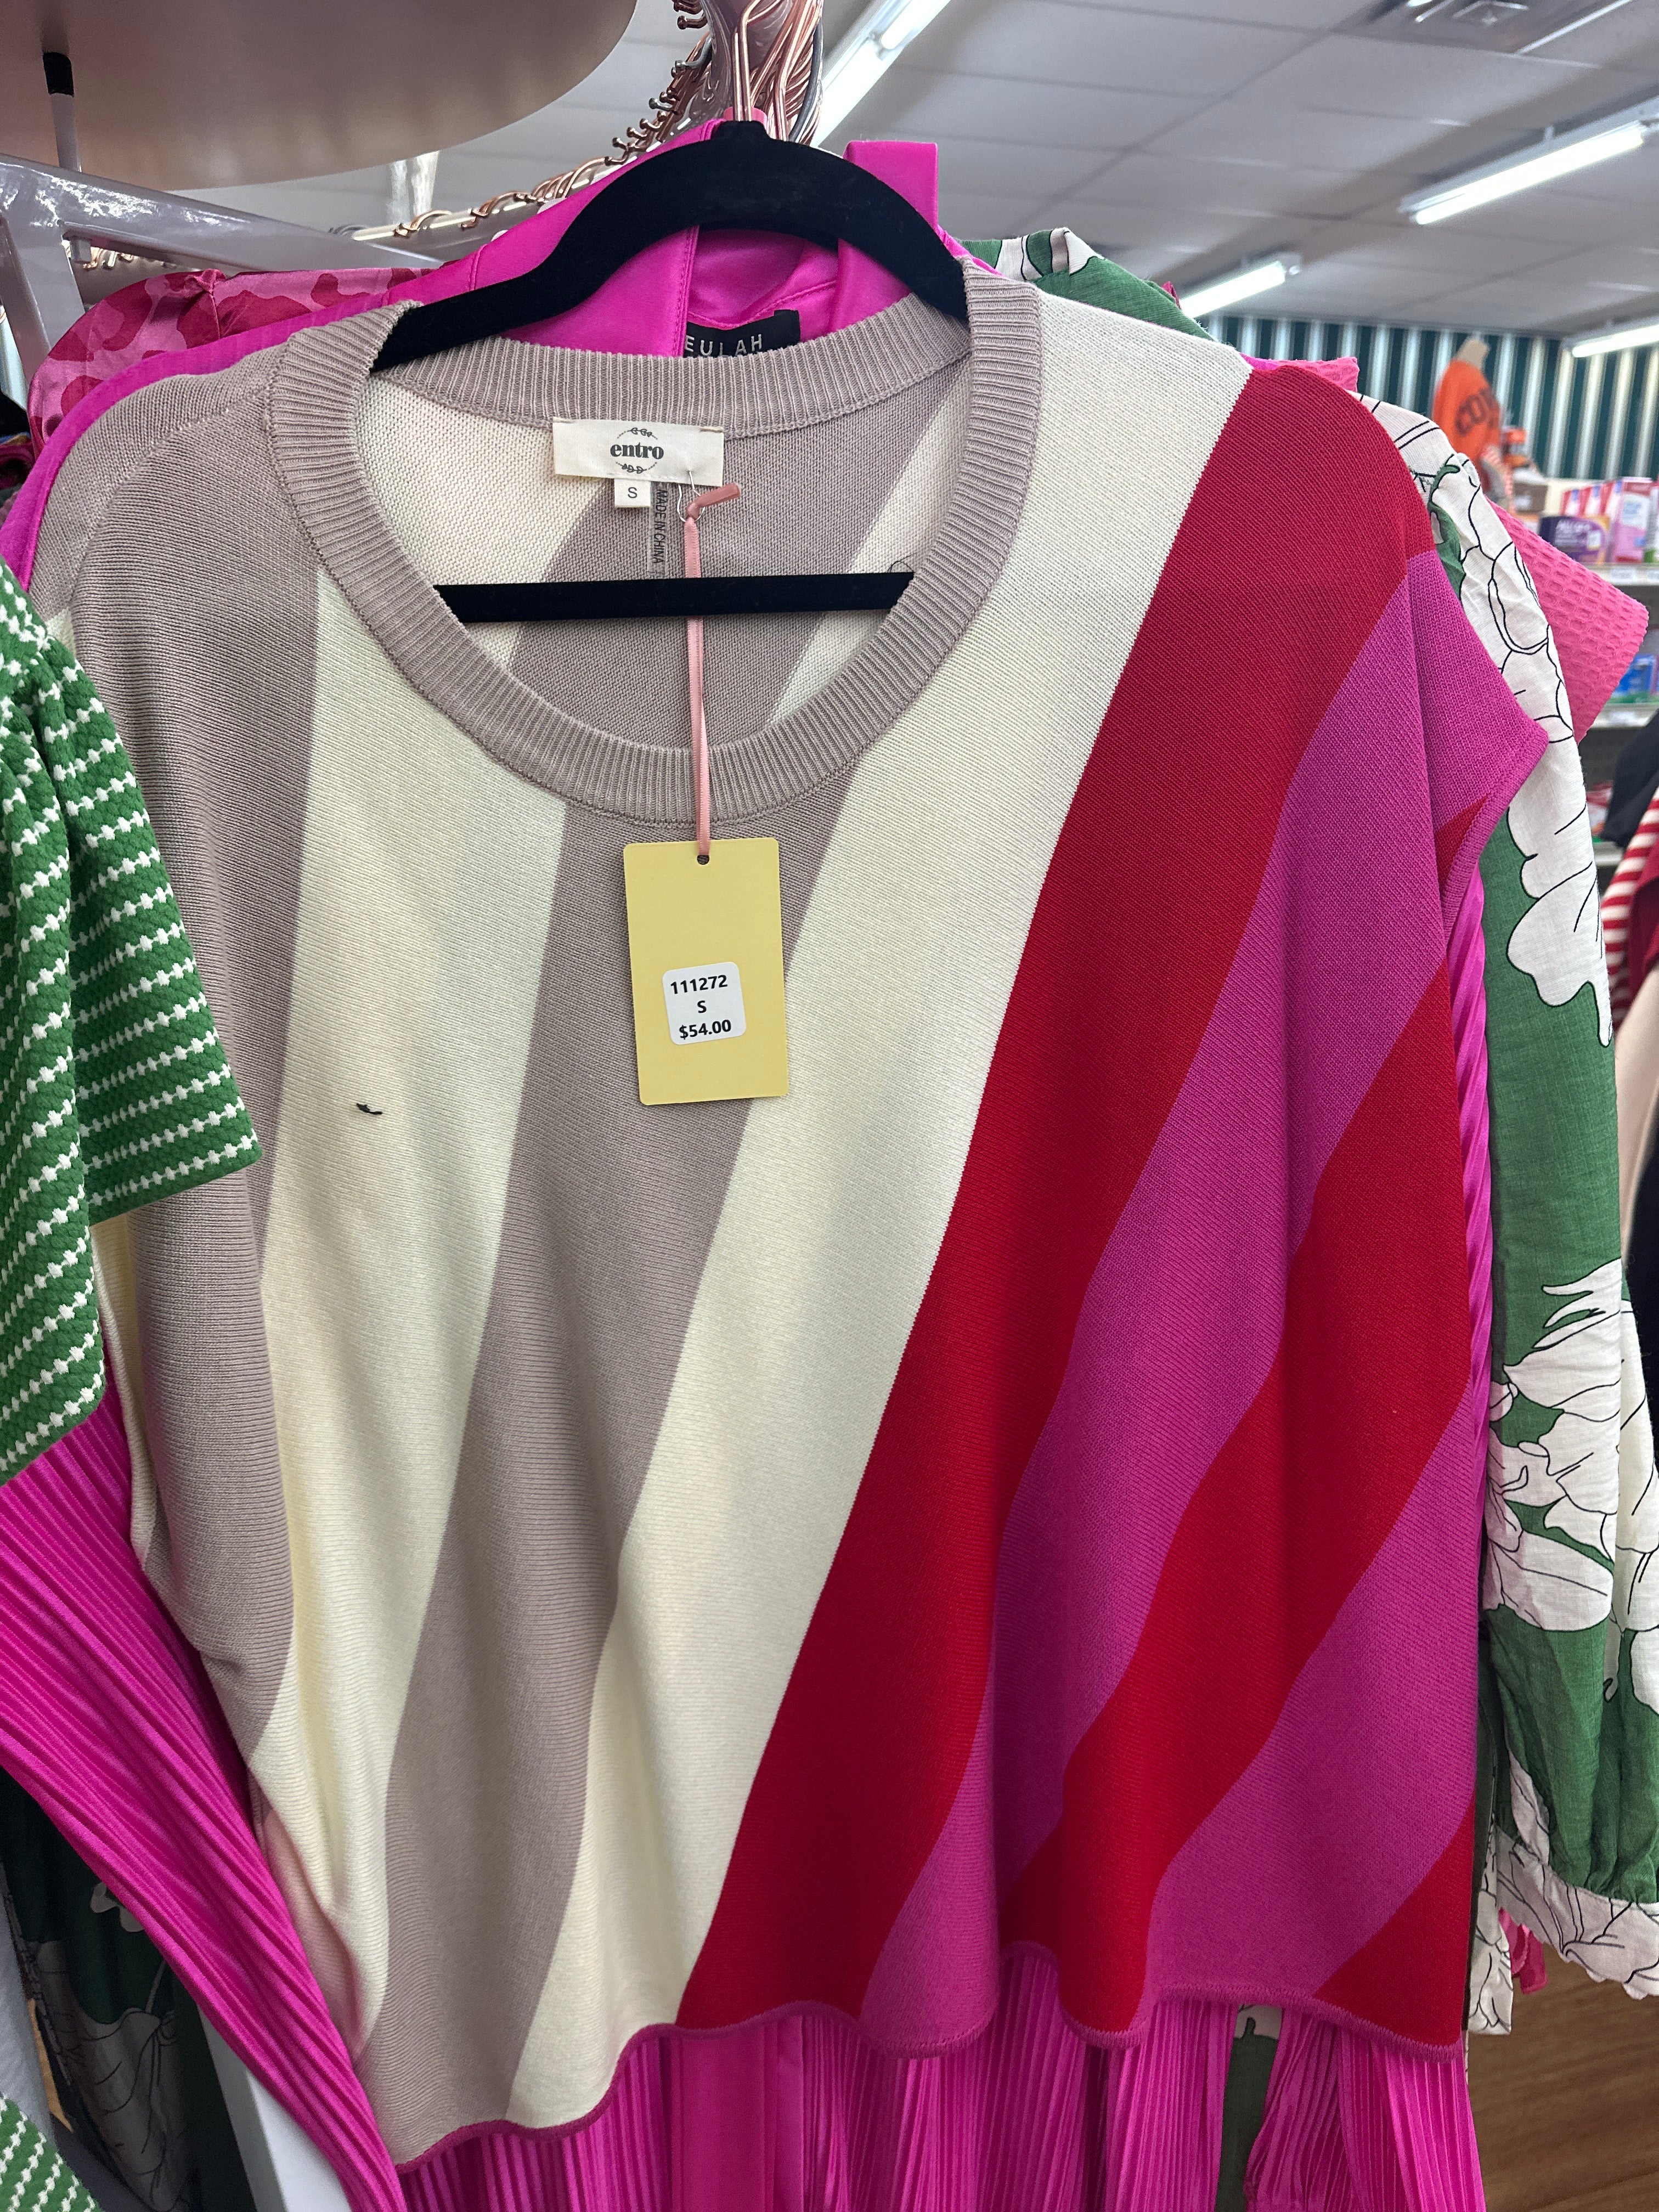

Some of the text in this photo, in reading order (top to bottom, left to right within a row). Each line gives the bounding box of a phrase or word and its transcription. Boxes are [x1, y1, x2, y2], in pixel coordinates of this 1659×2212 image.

[684, 334, 762, 357] EULAH
[610, 442, 664, 460] entro
[627, 486, 638, 499] S
[652, 489, 668, 564] MADE IN CHINA
[670, 974, 728, 995] 111272
[697, 1000, 707, 1014] S
[679, 1019, 732, 1040] $54.00
